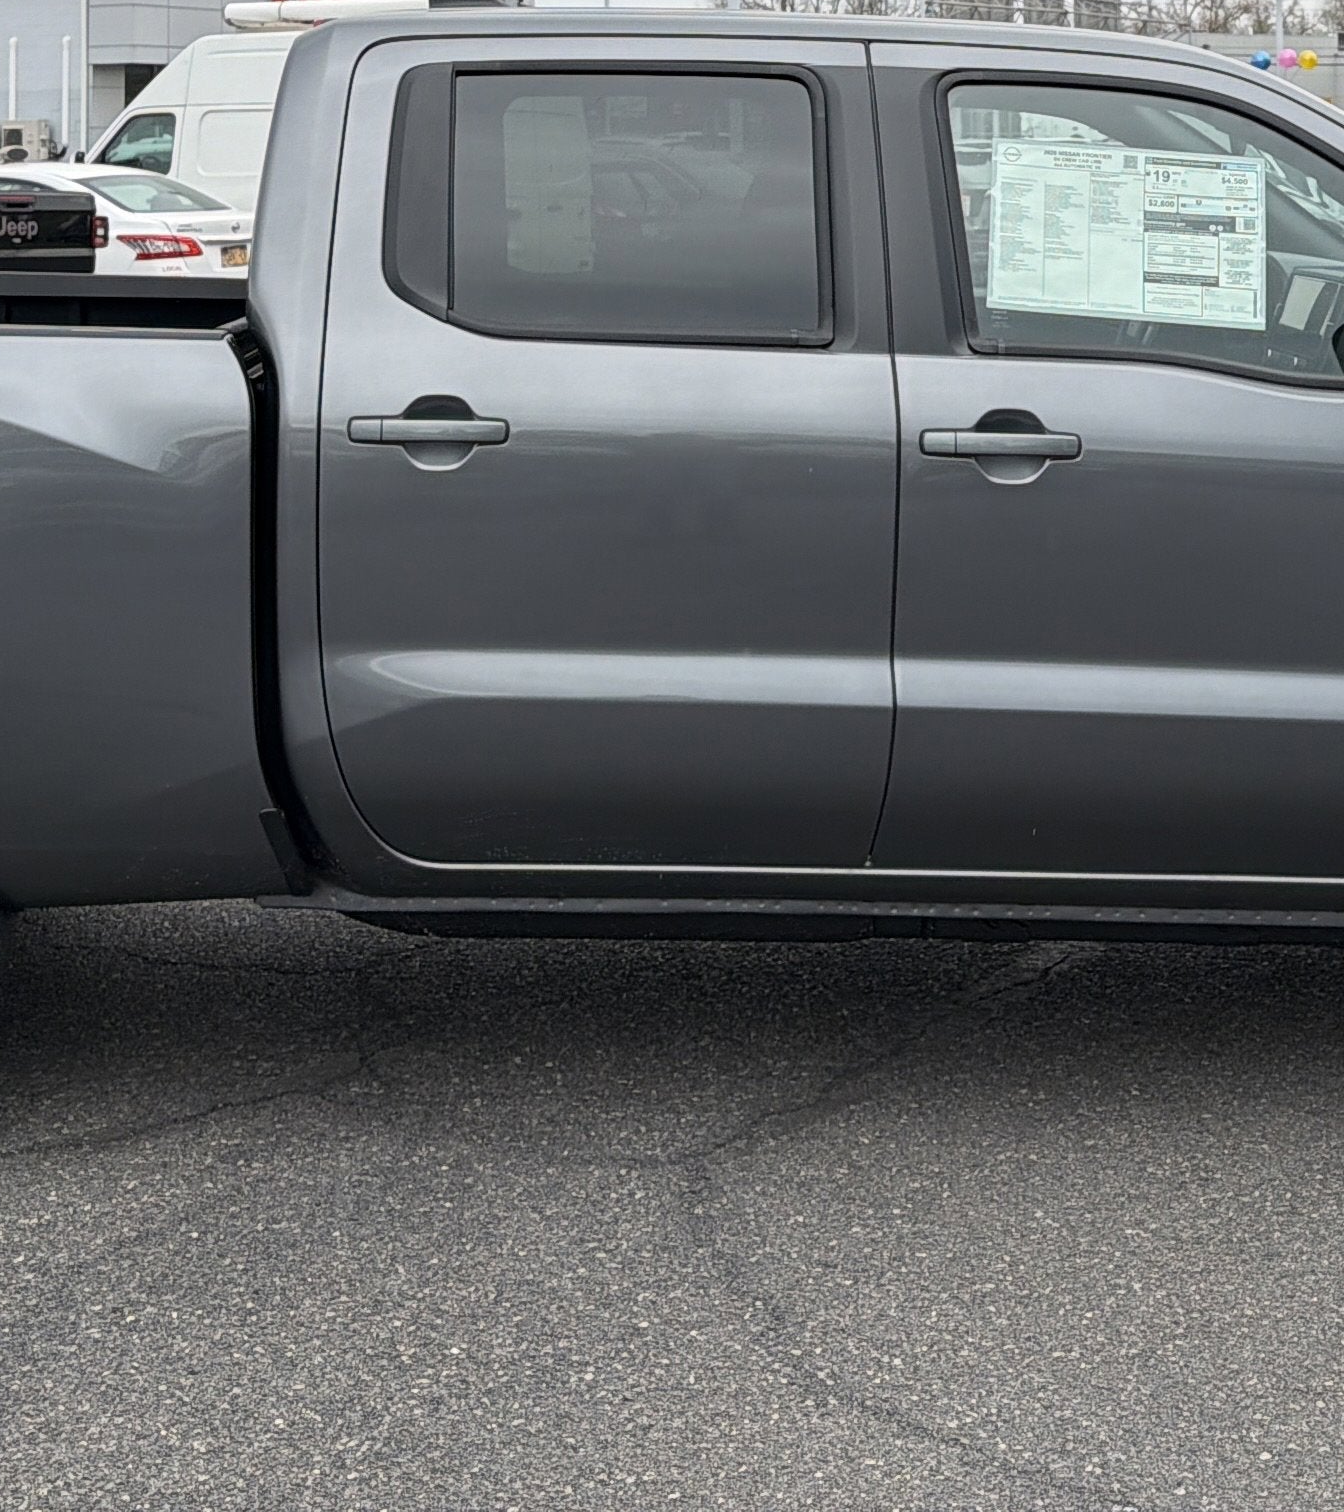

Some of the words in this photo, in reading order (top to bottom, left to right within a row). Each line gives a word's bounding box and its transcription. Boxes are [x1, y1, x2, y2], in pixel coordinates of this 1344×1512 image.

[1058, 150, 1081, 158] NISSAN
[1082, 152, 1113, 160] FRONTIER
[1153, 169, 1170, 183] 19
